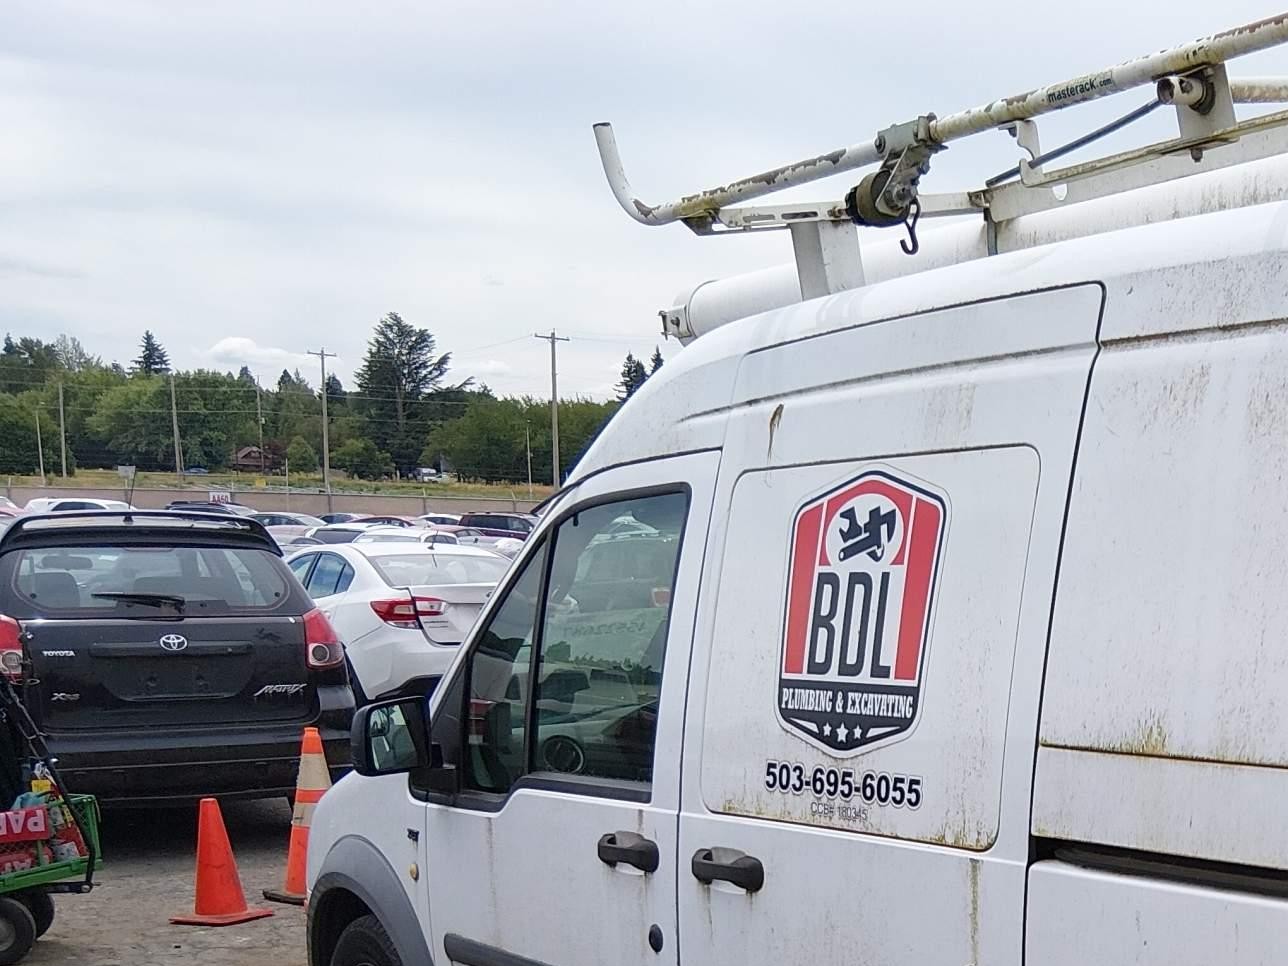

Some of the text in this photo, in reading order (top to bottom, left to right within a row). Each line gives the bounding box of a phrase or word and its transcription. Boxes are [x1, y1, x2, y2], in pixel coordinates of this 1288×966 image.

[807, 571, 892, 680] BDL
[782, 687, 913, 719] PLUMBING & EXCAVATING
[765, 762, 922, 808] 503-695-6055
[810, 801, 835, 817] CCB#
